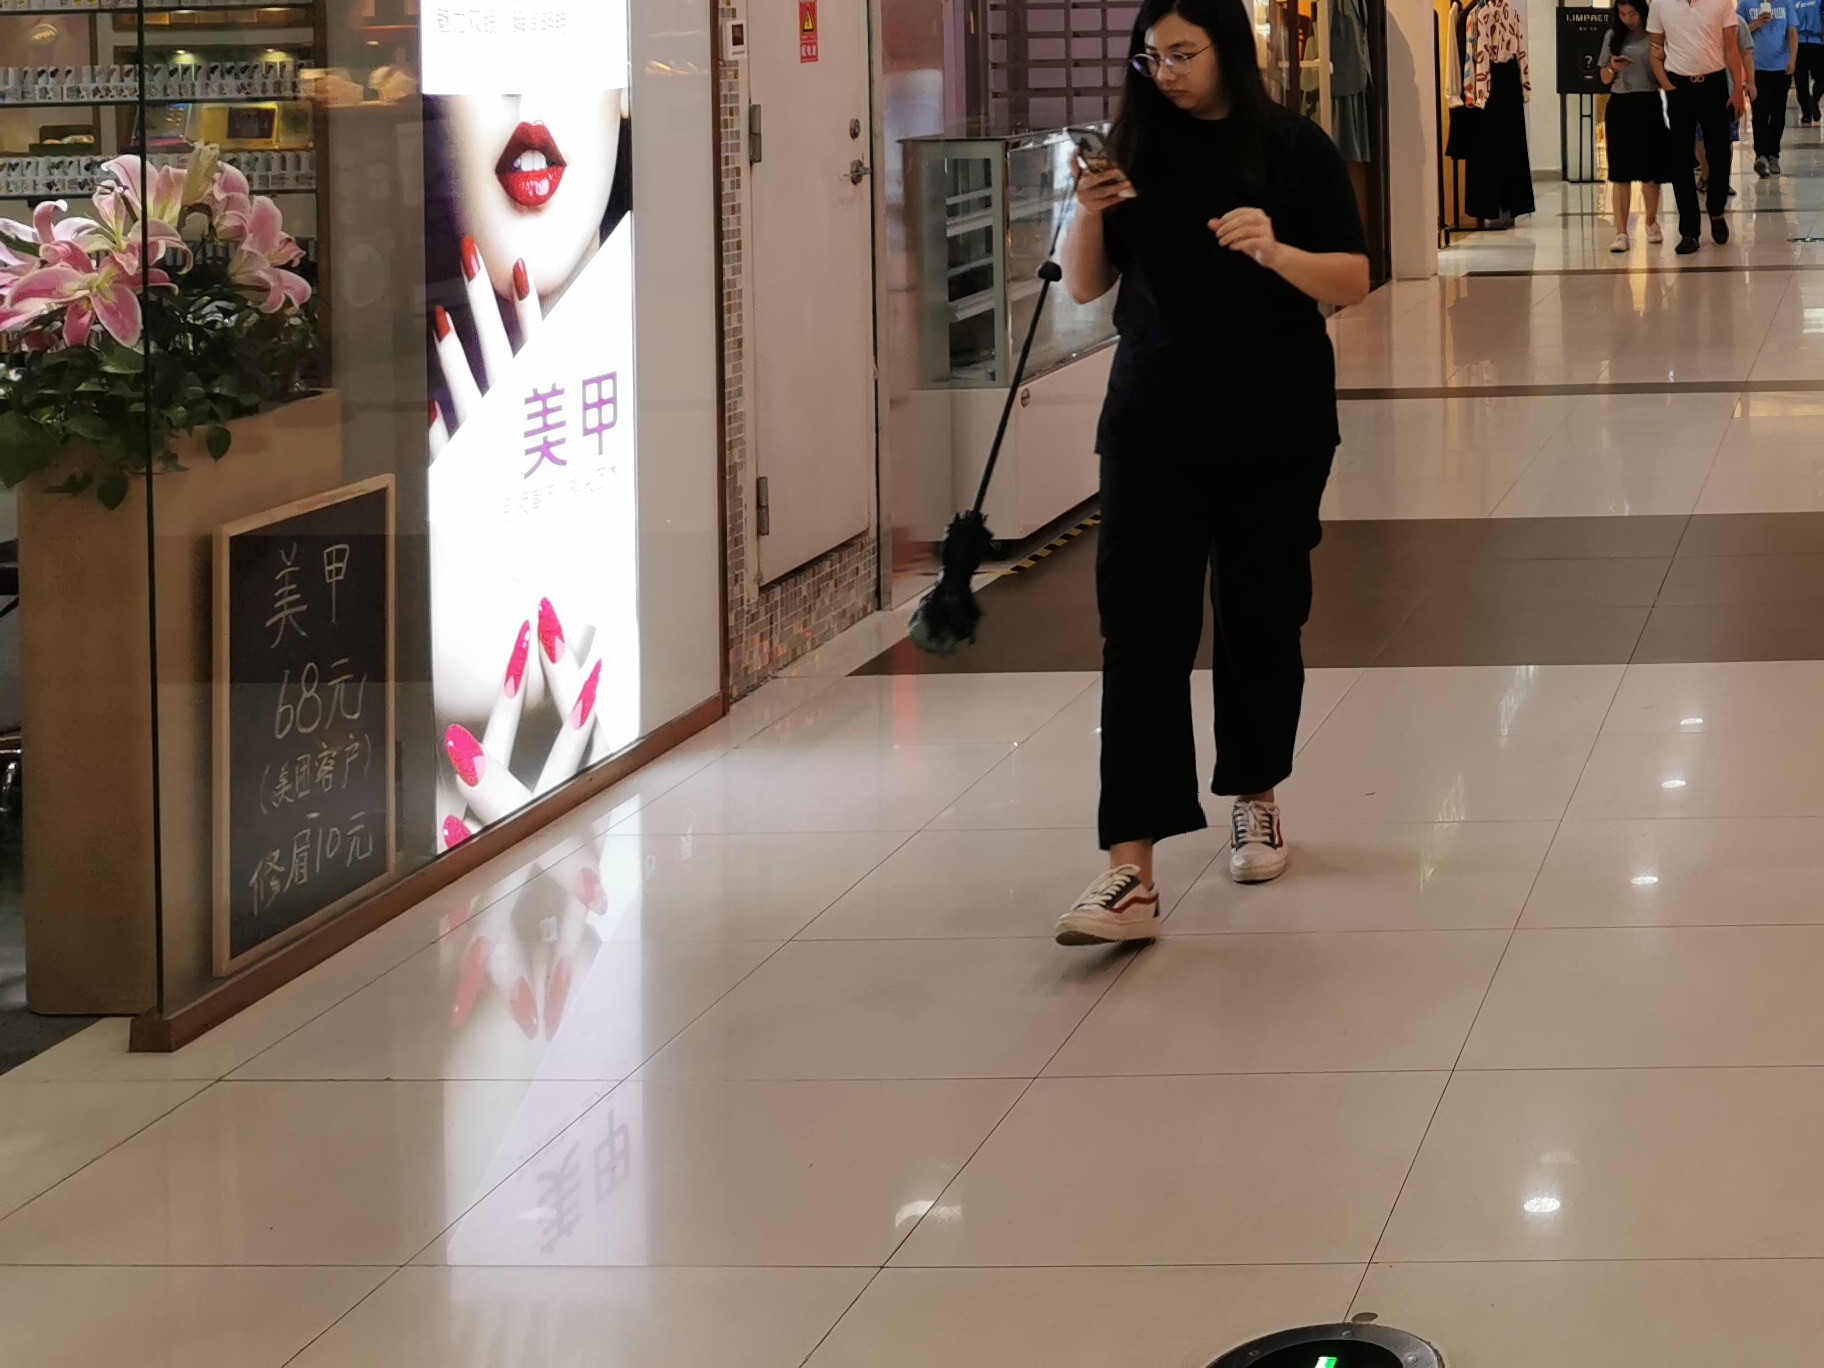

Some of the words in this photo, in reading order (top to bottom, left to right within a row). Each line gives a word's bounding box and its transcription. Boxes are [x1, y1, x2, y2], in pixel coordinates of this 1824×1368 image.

[524, 371, 617, 479] 美甲
[265, 543, 350, 649] 美甲
[274, 657, 368, 741] 68元
[248, 810, 374, 917] 修眉10元
